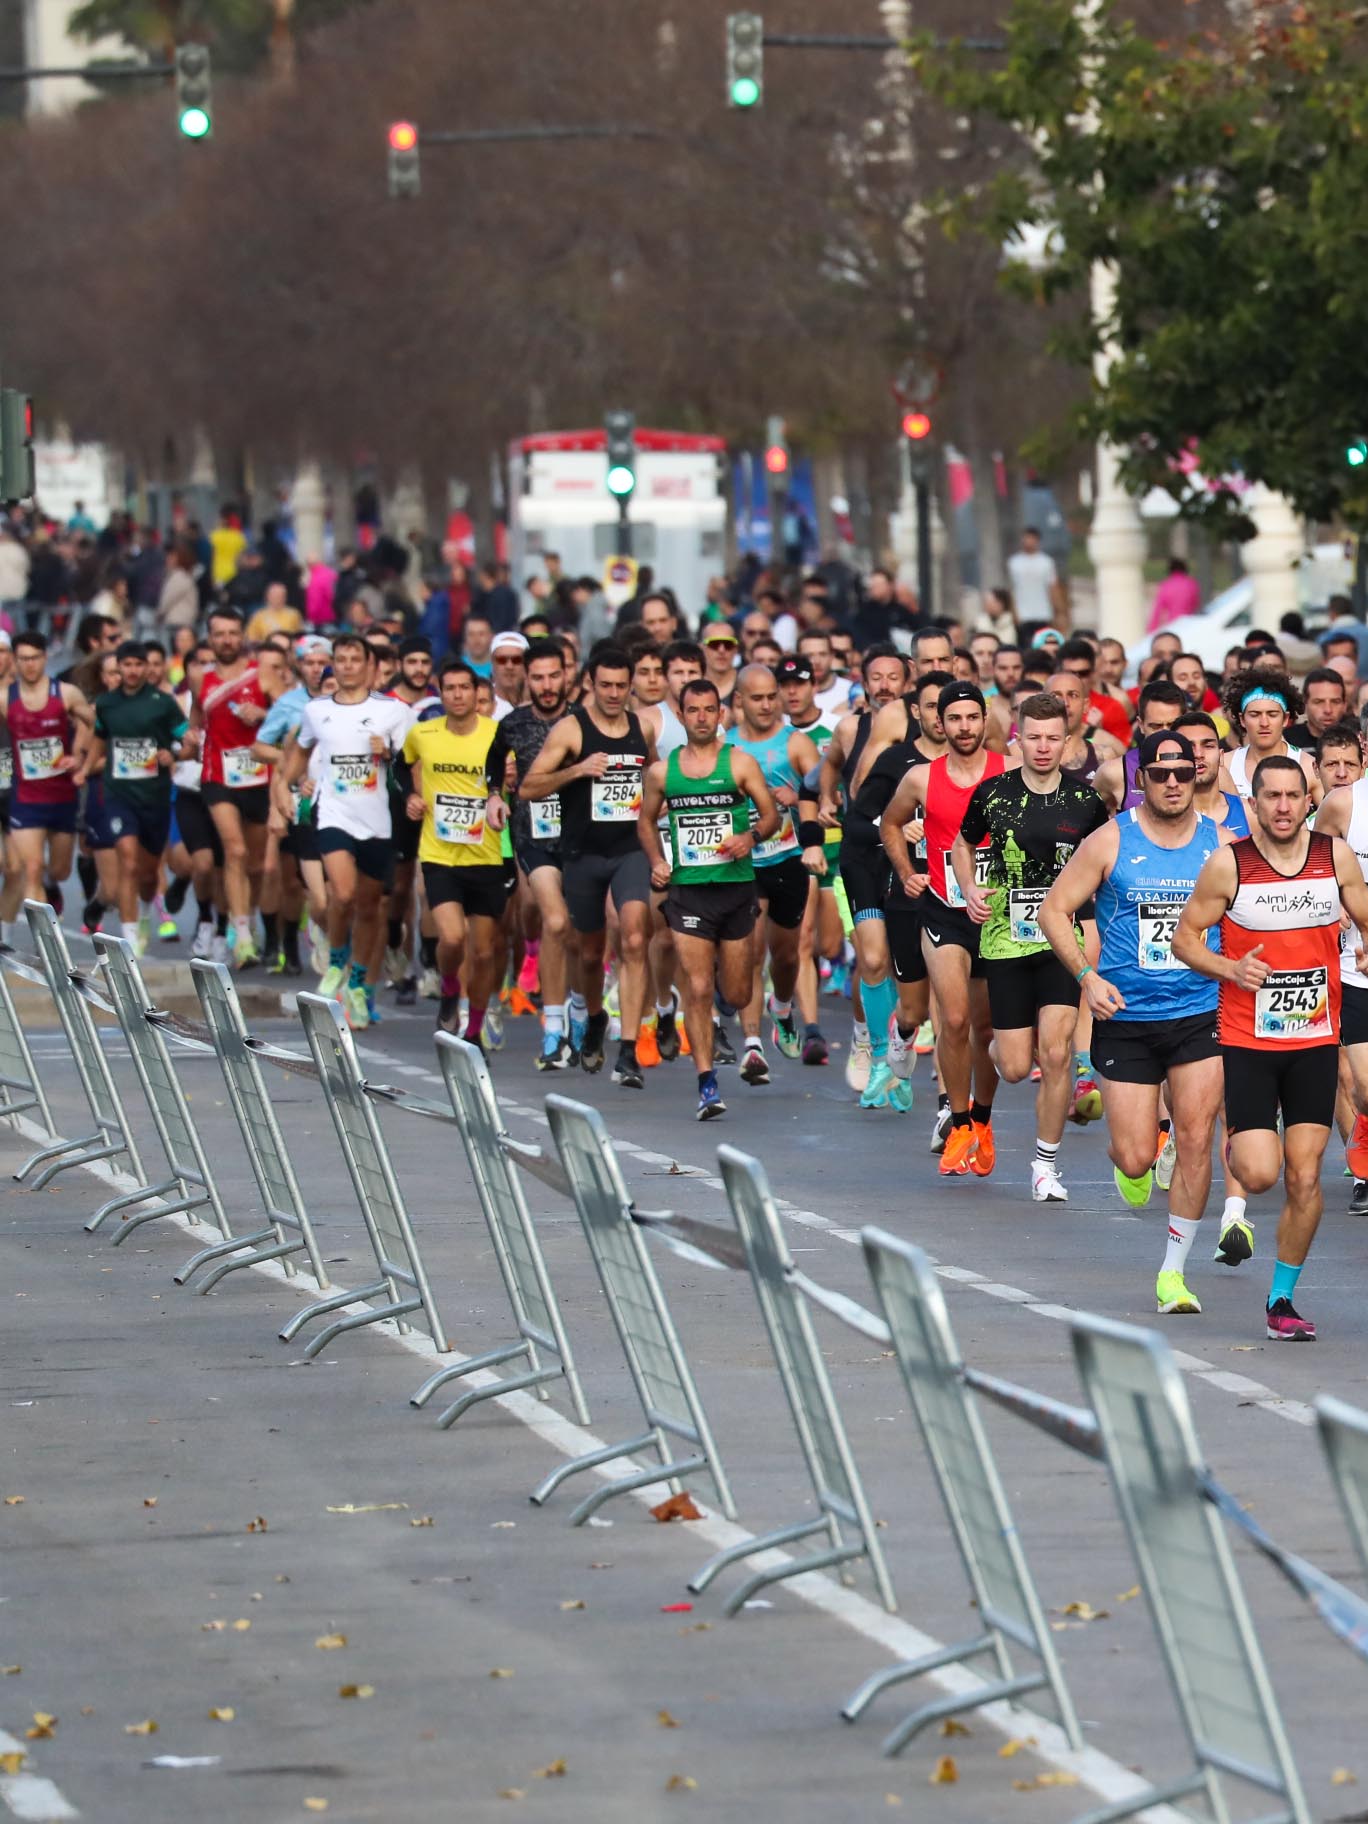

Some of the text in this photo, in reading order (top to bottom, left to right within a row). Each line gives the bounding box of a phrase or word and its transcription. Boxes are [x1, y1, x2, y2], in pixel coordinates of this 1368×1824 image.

[338, 766, 370, 780] 2004
[603, 785, 637, 801] 2584
[443, 807, 477, 826] 2231
[688, 828, 723, 846] 2075
[1160, 878, 1197, 888] ATLETIS
[1266, 975, 1306, 985] iberCaja
[1269, 987, 1319, 1012] 2543
